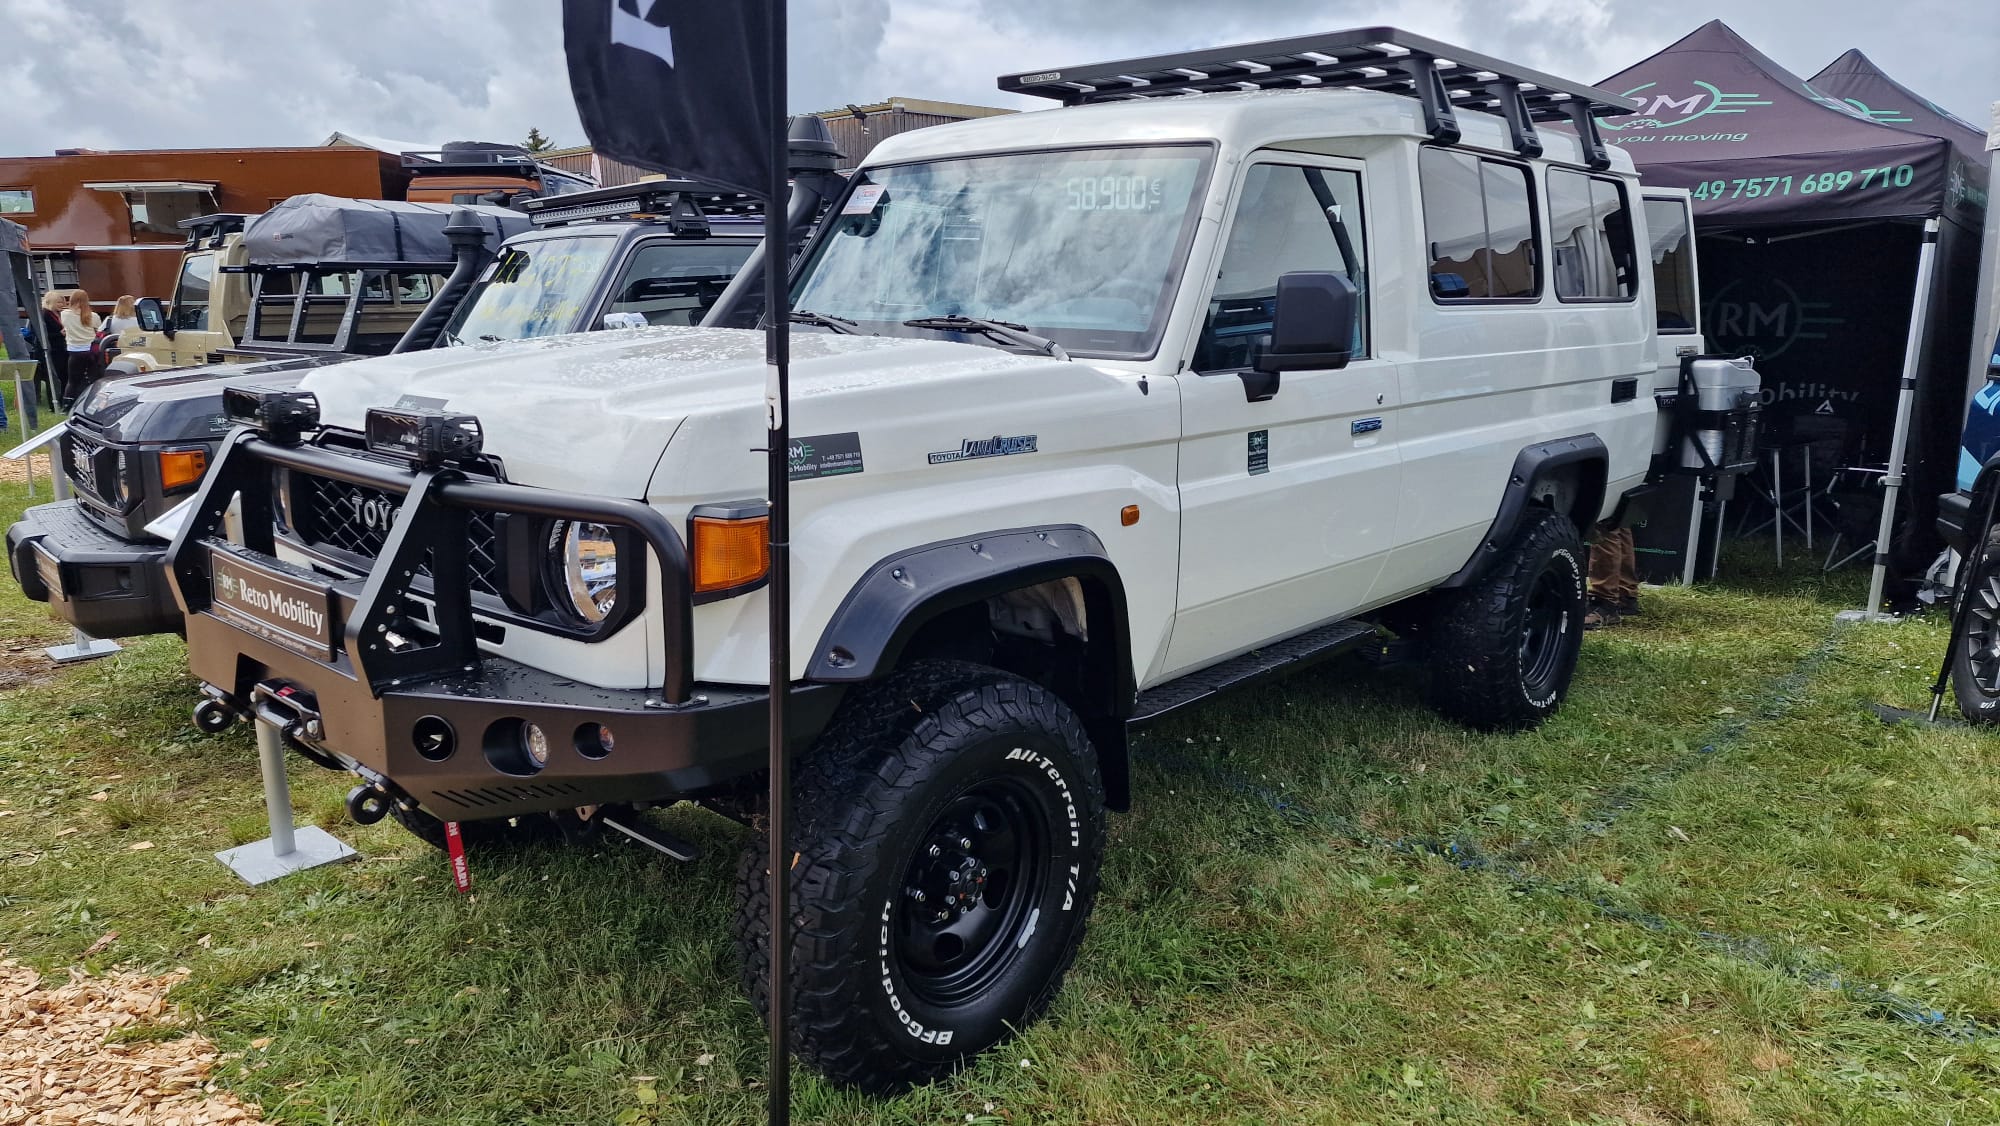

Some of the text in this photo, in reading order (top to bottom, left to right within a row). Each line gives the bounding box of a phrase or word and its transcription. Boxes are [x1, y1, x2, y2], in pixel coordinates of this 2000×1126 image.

[1612, 134, 1656, 145] you
[1662, 132, 1749, 142] moving
[1731, 175, 1793, 198] 7571
[1800, 171, 1853, 194] 689
[1859, 165, 1914, 190] 710
[1717, 302, 1790, 337] RM
[794, 463, 817, 473] Mobility
[931, 452, 961, 463] TOYOTA
[239, 577, 268, 610] Retro
[268, 589, 323, 635] Mobility
[1005, 748, 1080, 911] All-Terrain T/A
[454, 854, 469, 888] WARN
[879, 901, 954, 1045] BFGoodrich
